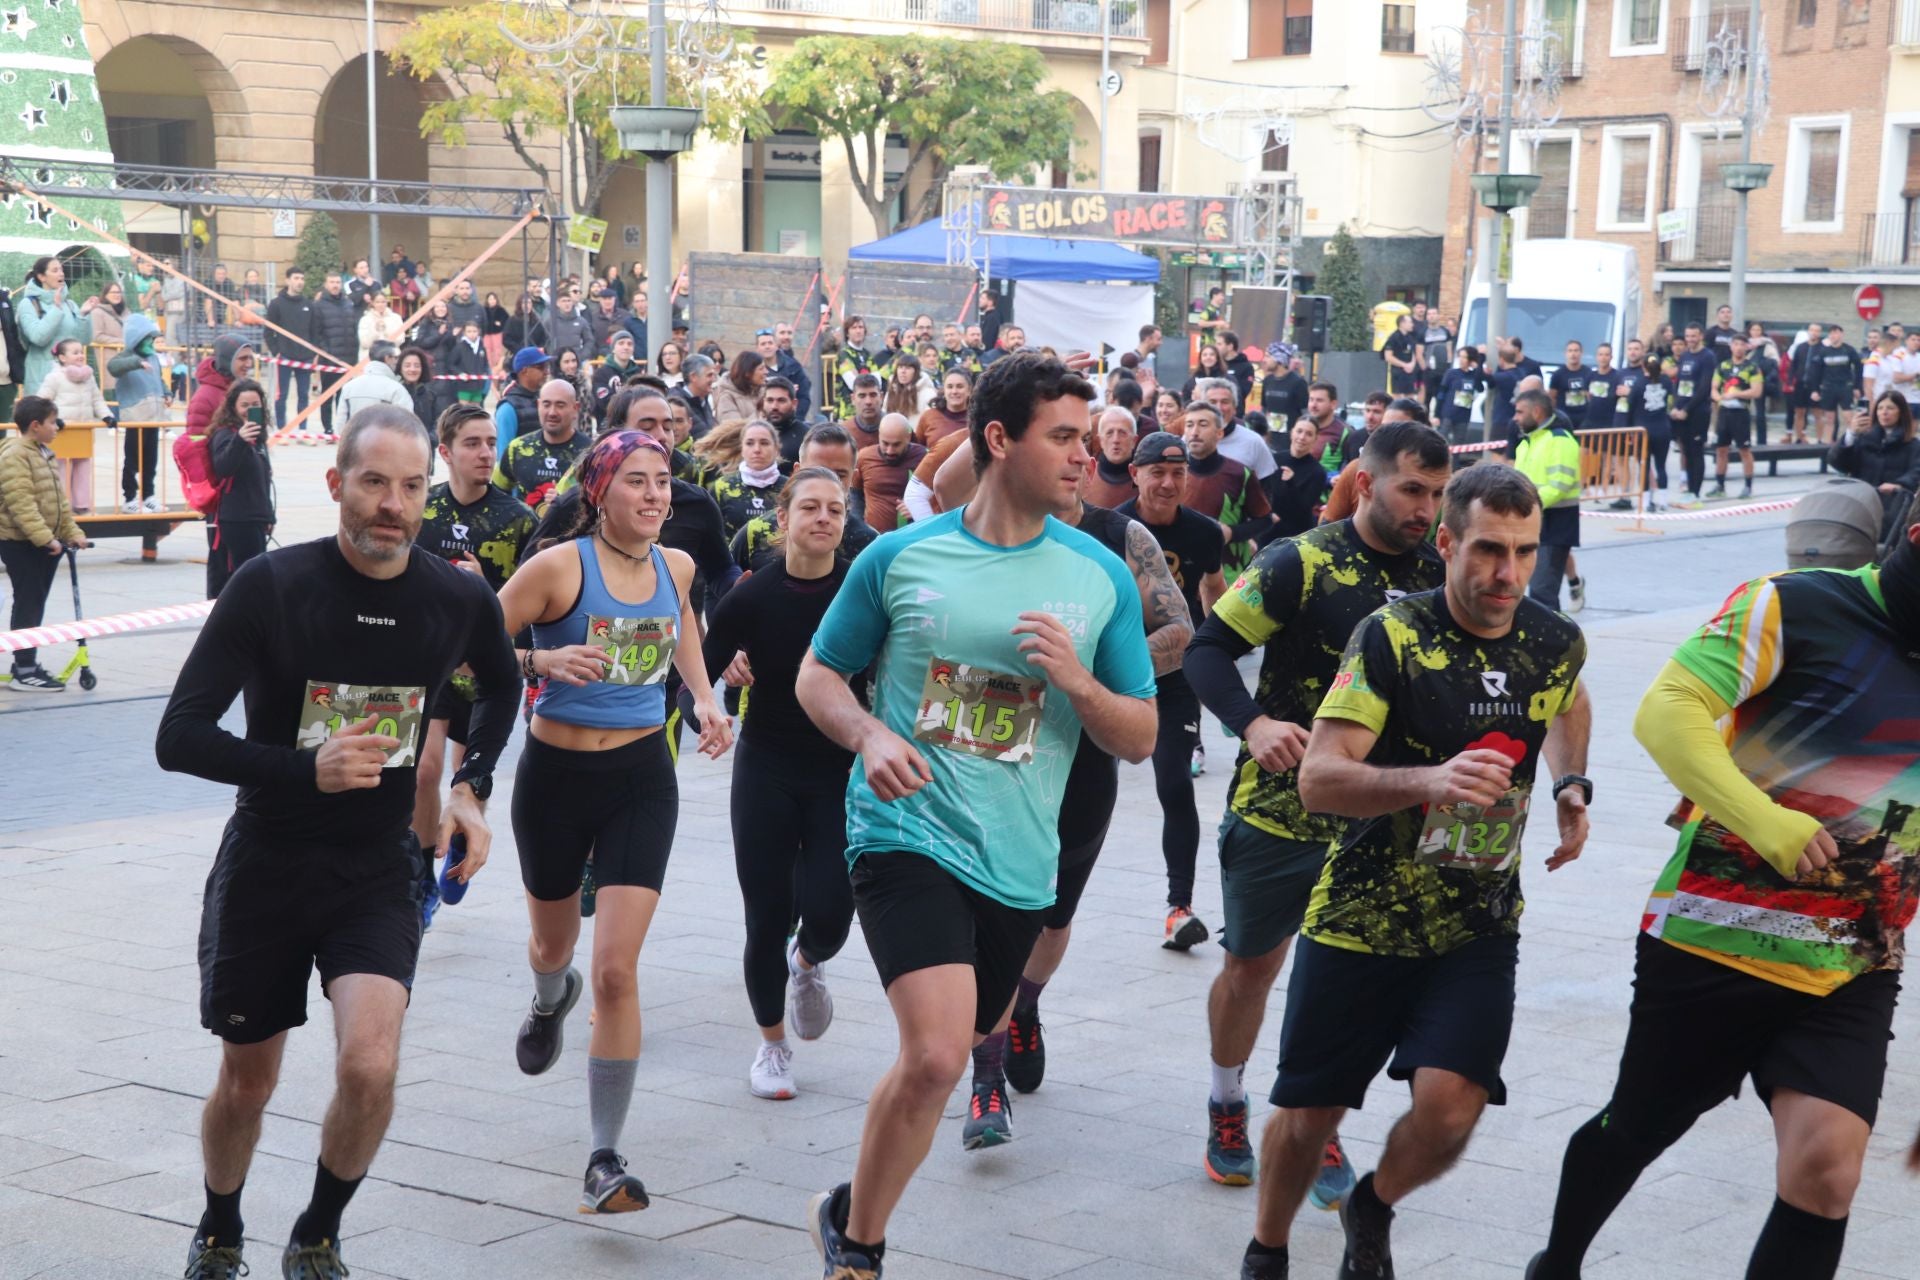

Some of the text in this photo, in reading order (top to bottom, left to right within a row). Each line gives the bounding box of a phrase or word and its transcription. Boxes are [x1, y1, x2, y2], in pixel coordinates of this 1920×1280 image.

[1017, 194, 1188, 237] EOLOS RACE
[356, 614, 396, 626] kipsta
[636, 623, 660, 632] RACE
[603, 643, 659, 672] 149
[986, 677, 1022, 693] RACE
[368, 693, 400, 703] RACE
[945, 695, 1017, 743] 115
[1447, 820, 1511, 855] 132
